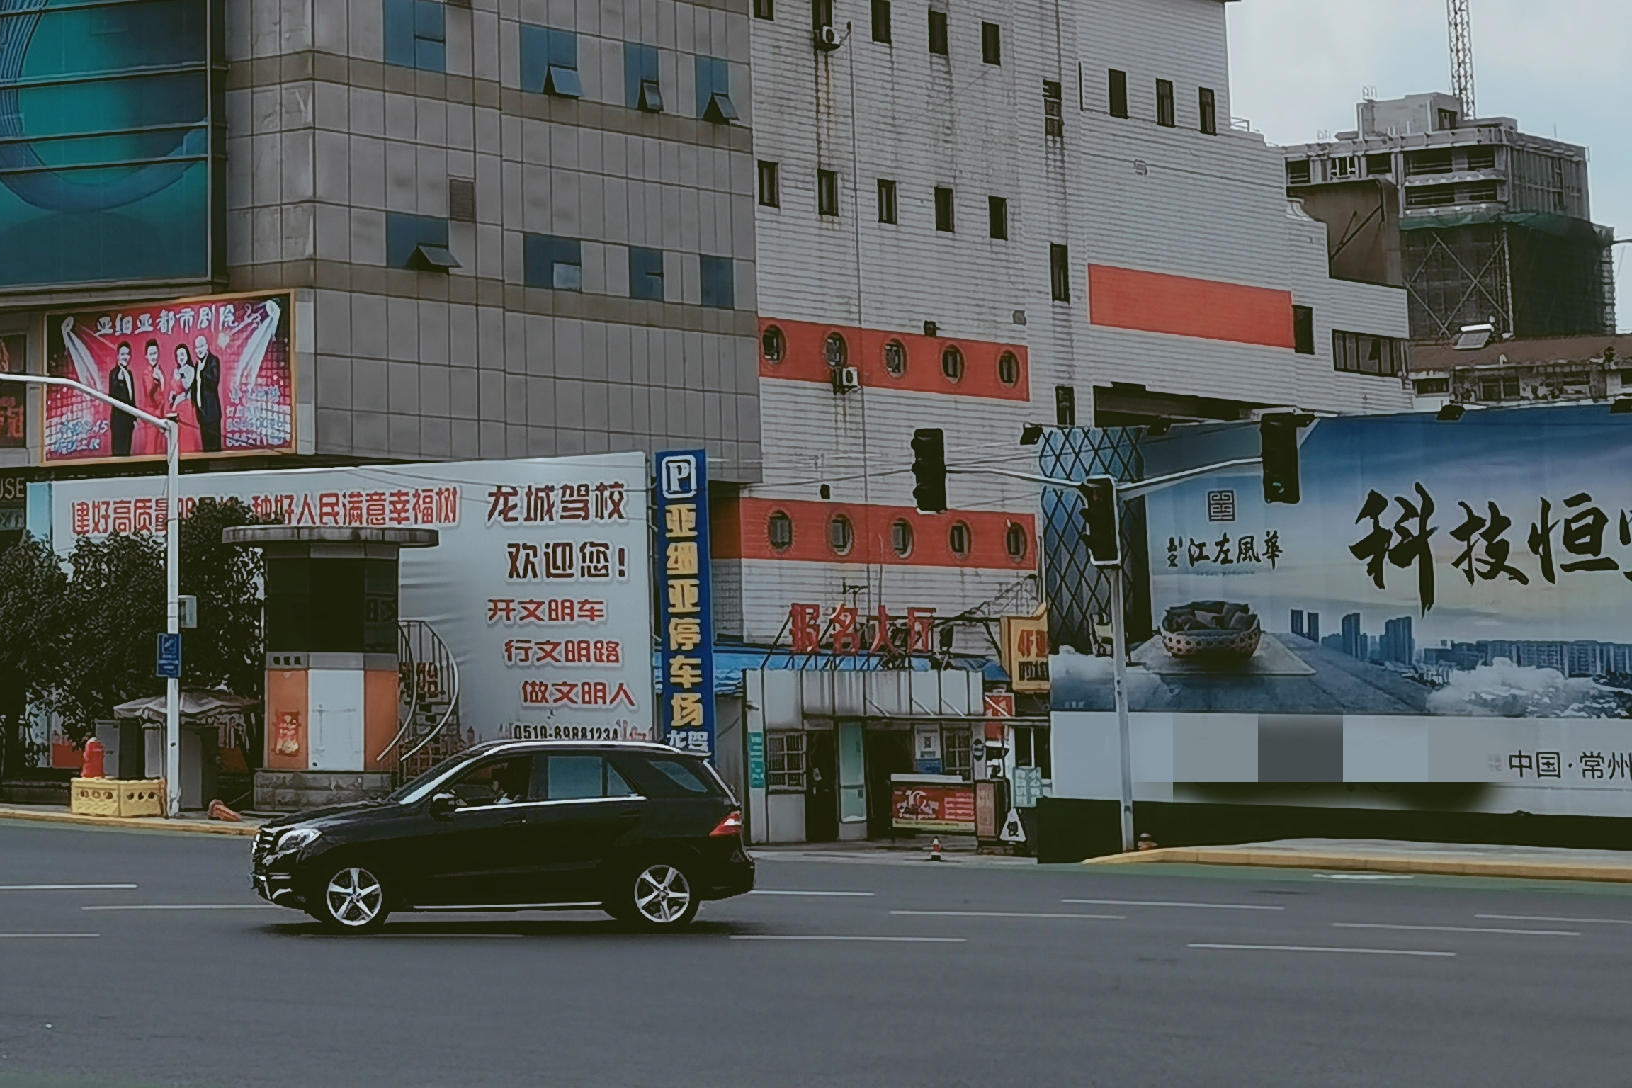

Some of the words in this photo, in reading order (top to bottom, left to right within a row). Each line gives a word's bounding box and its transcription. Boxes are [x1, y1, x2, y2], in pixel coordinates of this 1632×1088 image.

[94, 303, 239, 336] 亚细亚都市剧院
[486, 481, 629, 524] 龙城驾校
[1347, 480, 1632, 618] 科技恒
[486, 598, 605, 624] 开文明车
[665, 503, 704, 727] 亚细亚停车场
[789, 602, 937, 656] 报名大厅
[504, 639, 621, 666] 行文明路
[521, 680, 636, 708] 做文明人
